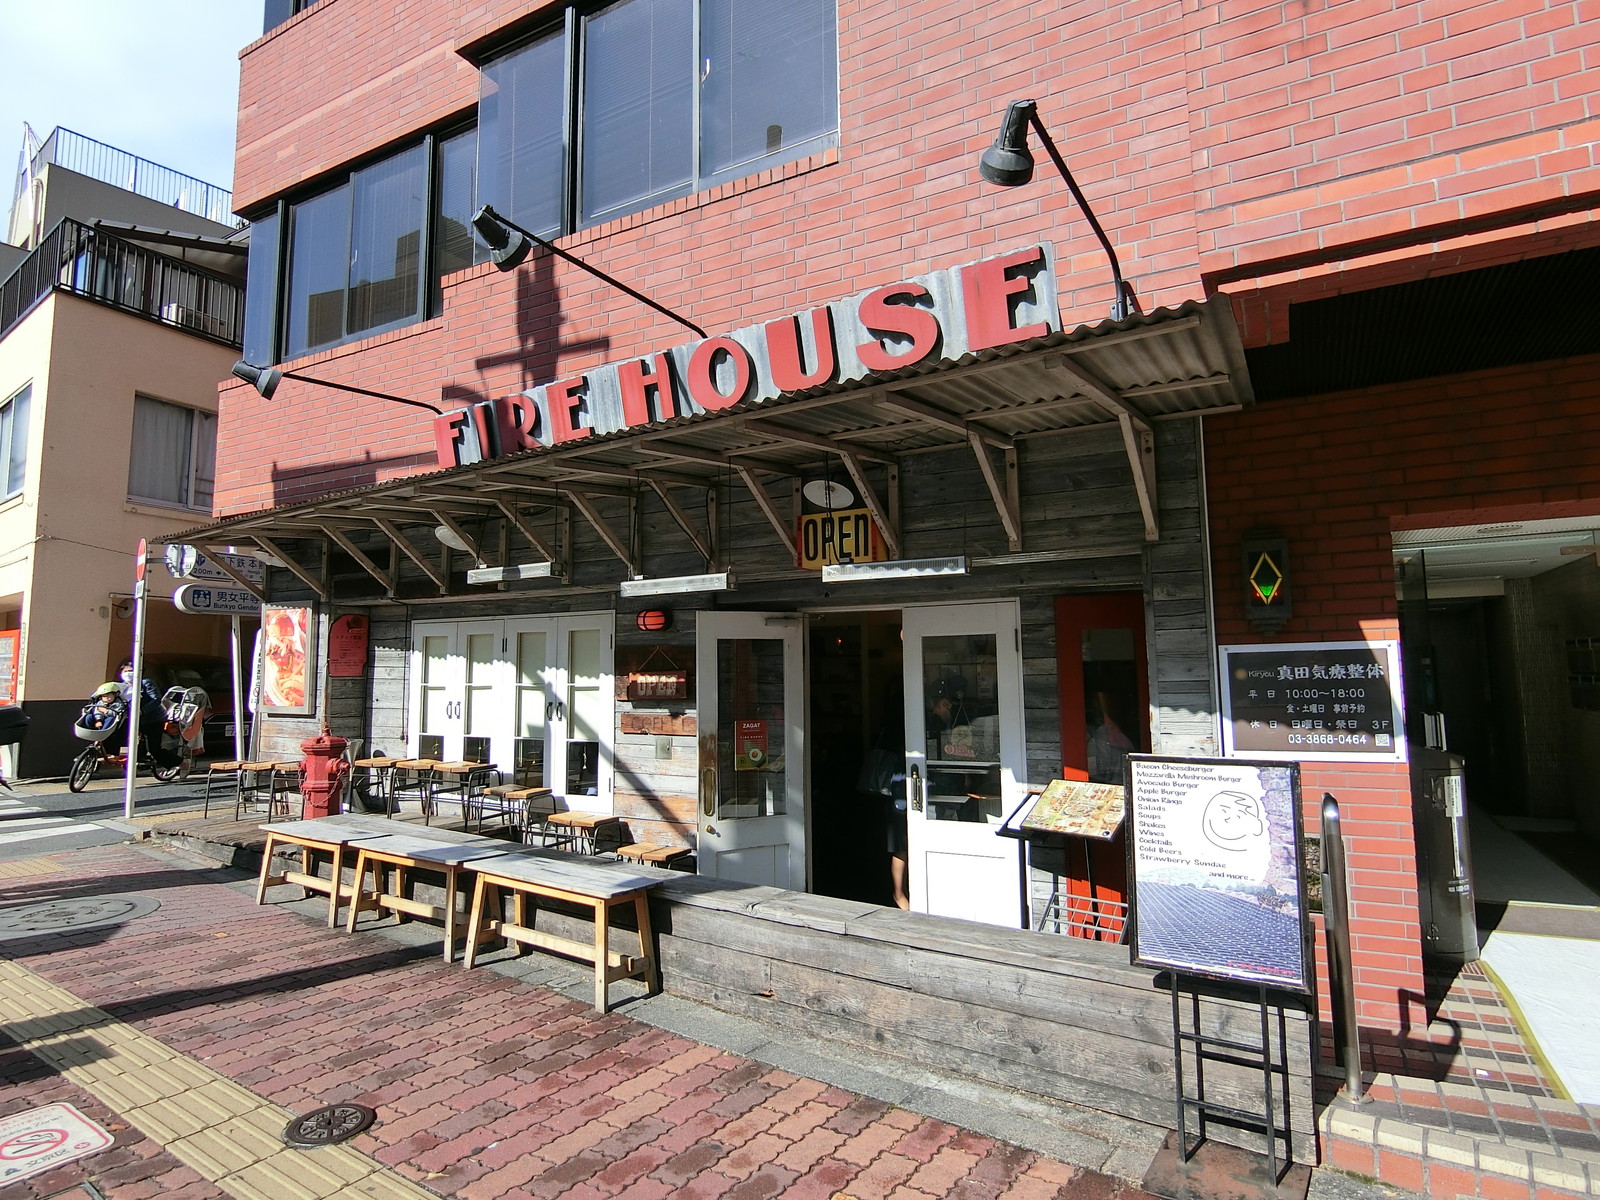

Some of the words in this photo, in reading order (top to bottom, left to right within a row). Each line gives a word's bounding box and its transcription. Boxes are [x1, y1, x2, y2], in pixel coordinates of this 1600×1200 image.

[434, 376, 594, 469] FIRE
[618, 248, 1050, 427] HOUSE
[213, 602, 236, 610] Bunkyo
[1248, 669, 1275, 679] Kiryou
[1276, 663, 1385, 681] 真田気療整体
[637, 675, 677, 696] OPEN
[1287, 734, 1367, 745] 03-3868-0464
[1161, 764, 1215, 773] Cheeseburger
[1218, 775, 1242, 783] Burger
[1137, 779, 1170, 787] Avocado
[1172, 781, 1199, 789] Burger
[1137, 787, 1159, 795] Apple
[1161, 788, 1187, 796] Burger
[1161, 797, 1183, 805] Rings
[1138, 804, 1166, 812] Salads
[1138, 812, 1161, 820] Soups
[1139, 821, 1166, 829] Shakes
[1139, 829, 1164, 837] Wines
[1139, 837, 1173, 846] Cocktails
[1139, 845, 1156, 853] Cold
[1159, 847, 1182, 855] Beers
[1140, 854, 1191, 866] Strawberry
[1194, 859, 1226, 869] Sundae
